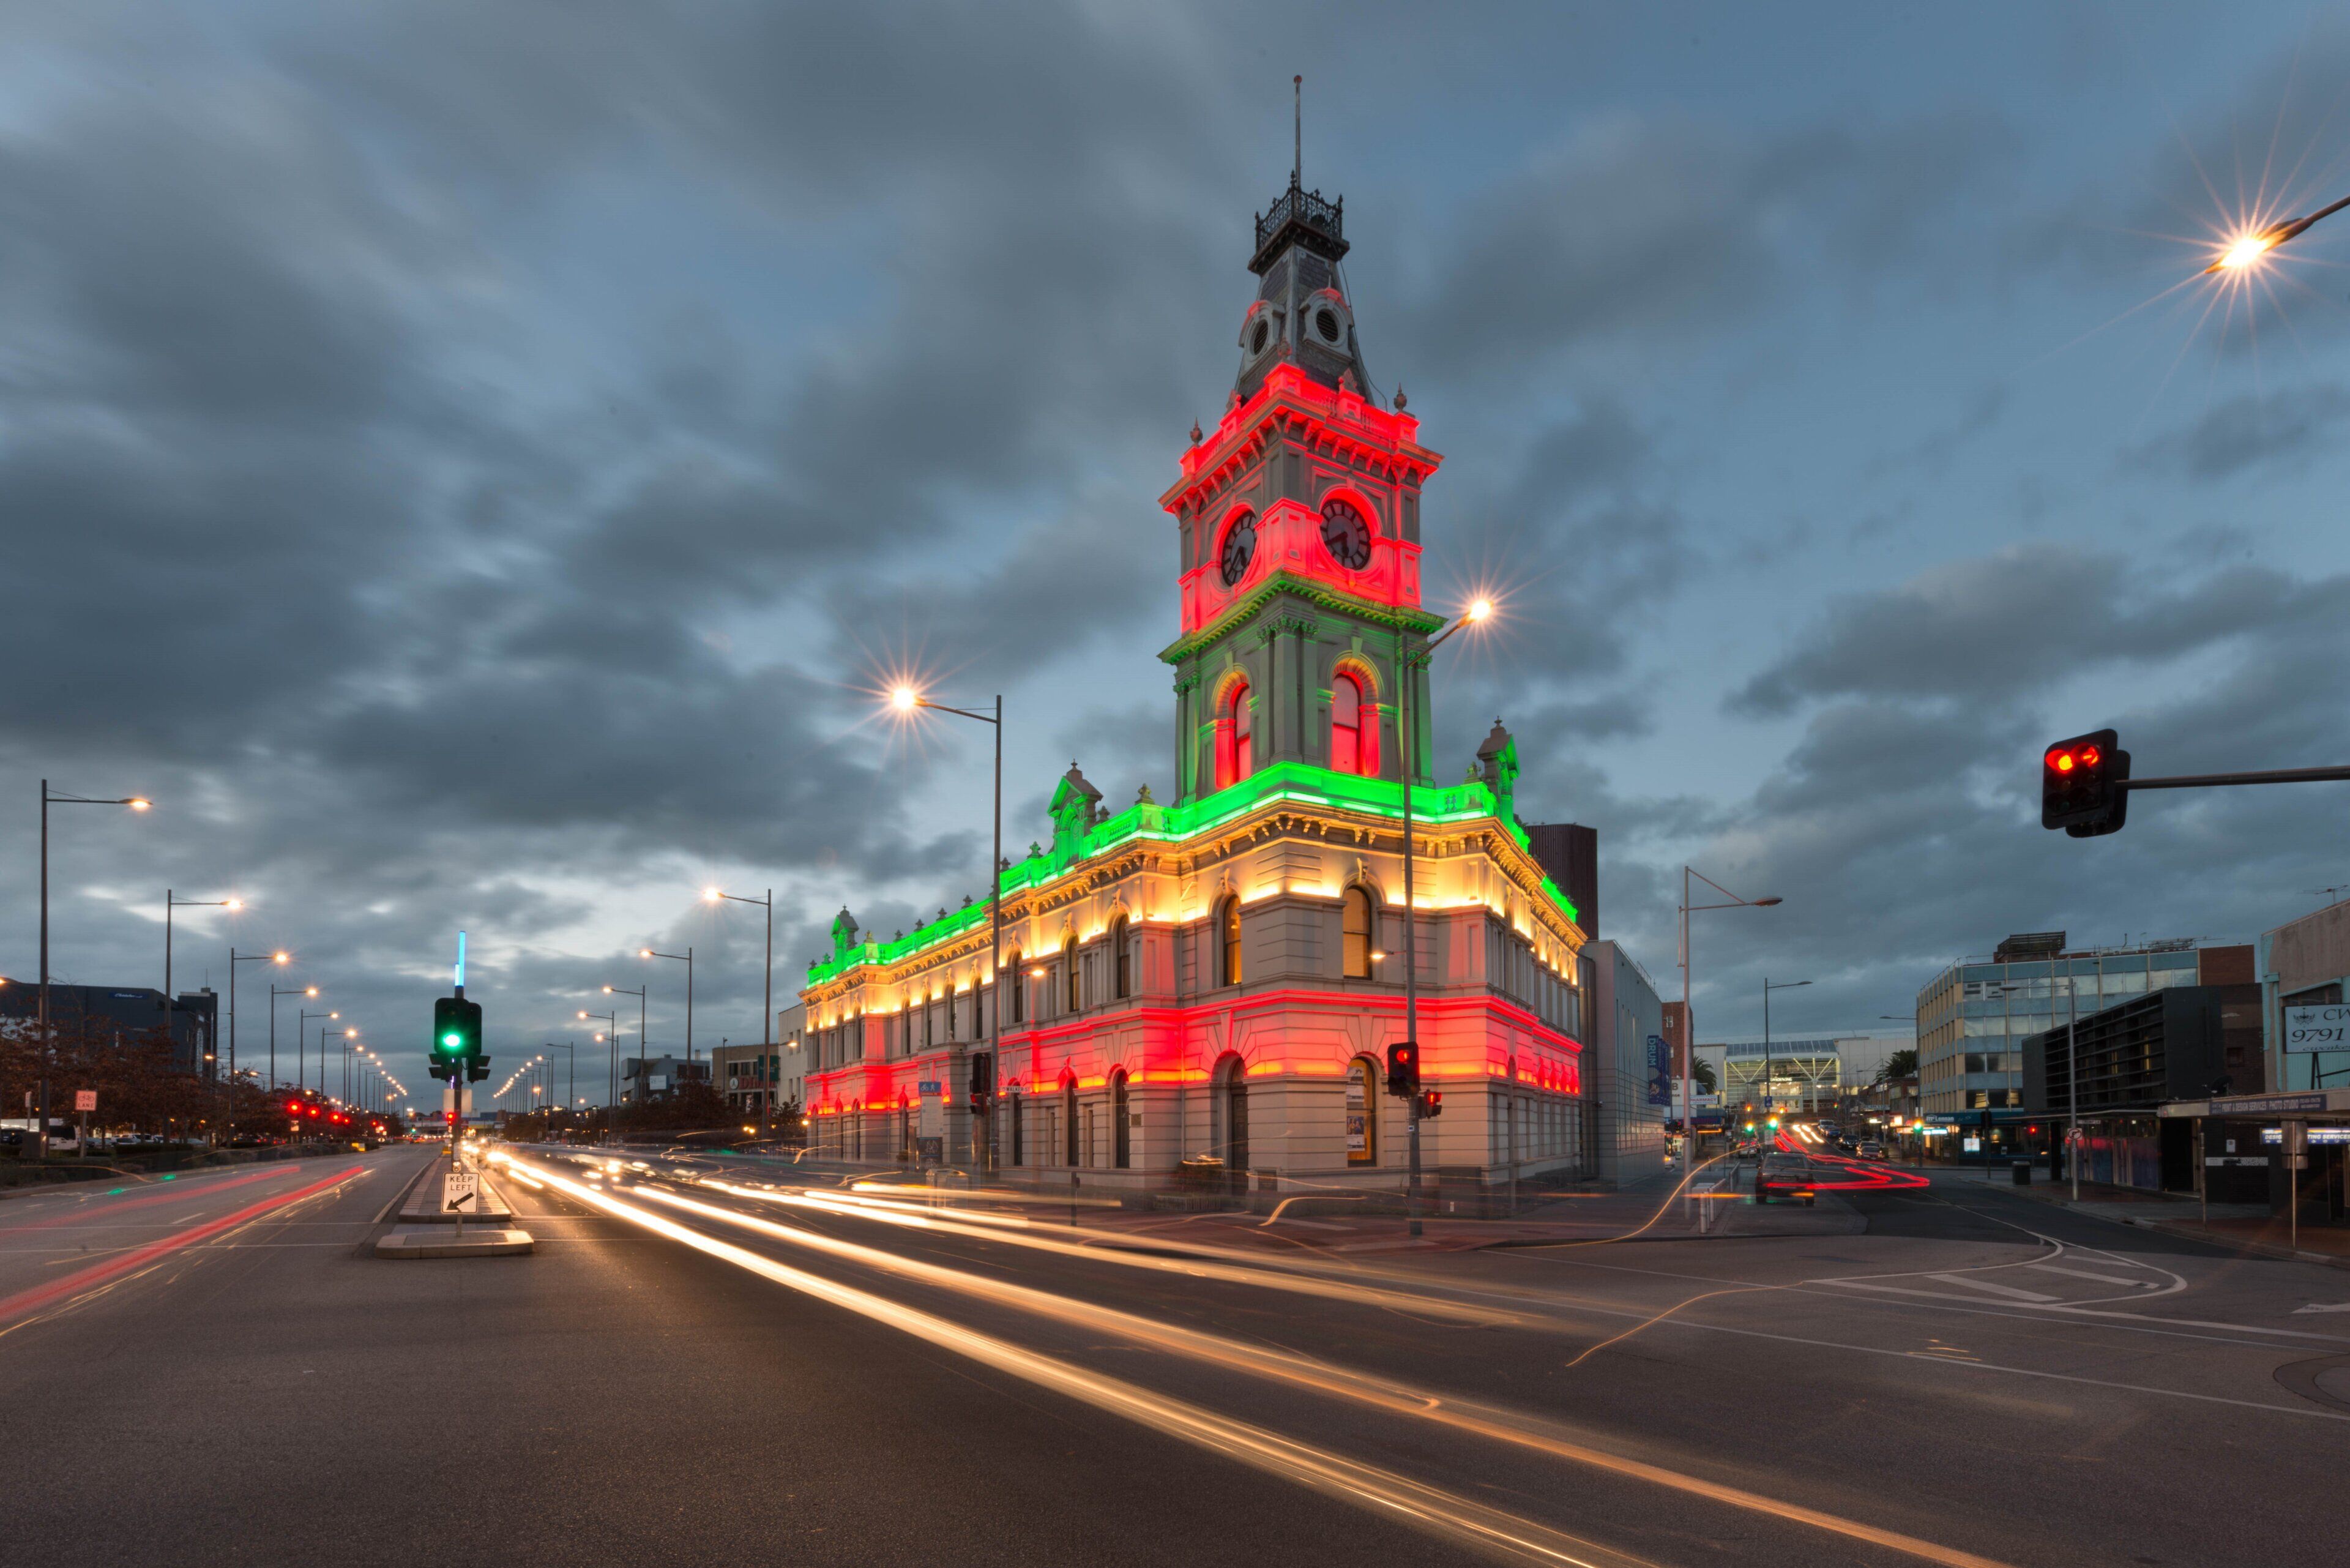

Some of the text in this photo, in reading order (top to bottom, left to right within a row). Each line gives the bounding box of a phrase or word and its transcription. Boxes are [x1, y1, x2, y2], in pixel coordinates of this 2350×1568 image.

[2291, 1028, 2345, 1043] 9791
[2236, 1102, 2248, 1111] DESIGN
[2249, 1101, 2266, 1111] SERVICES
[2269, 1100, 2282, 1110] PHOTO
[2283, 1099, 2299, 1110] STUDIO
